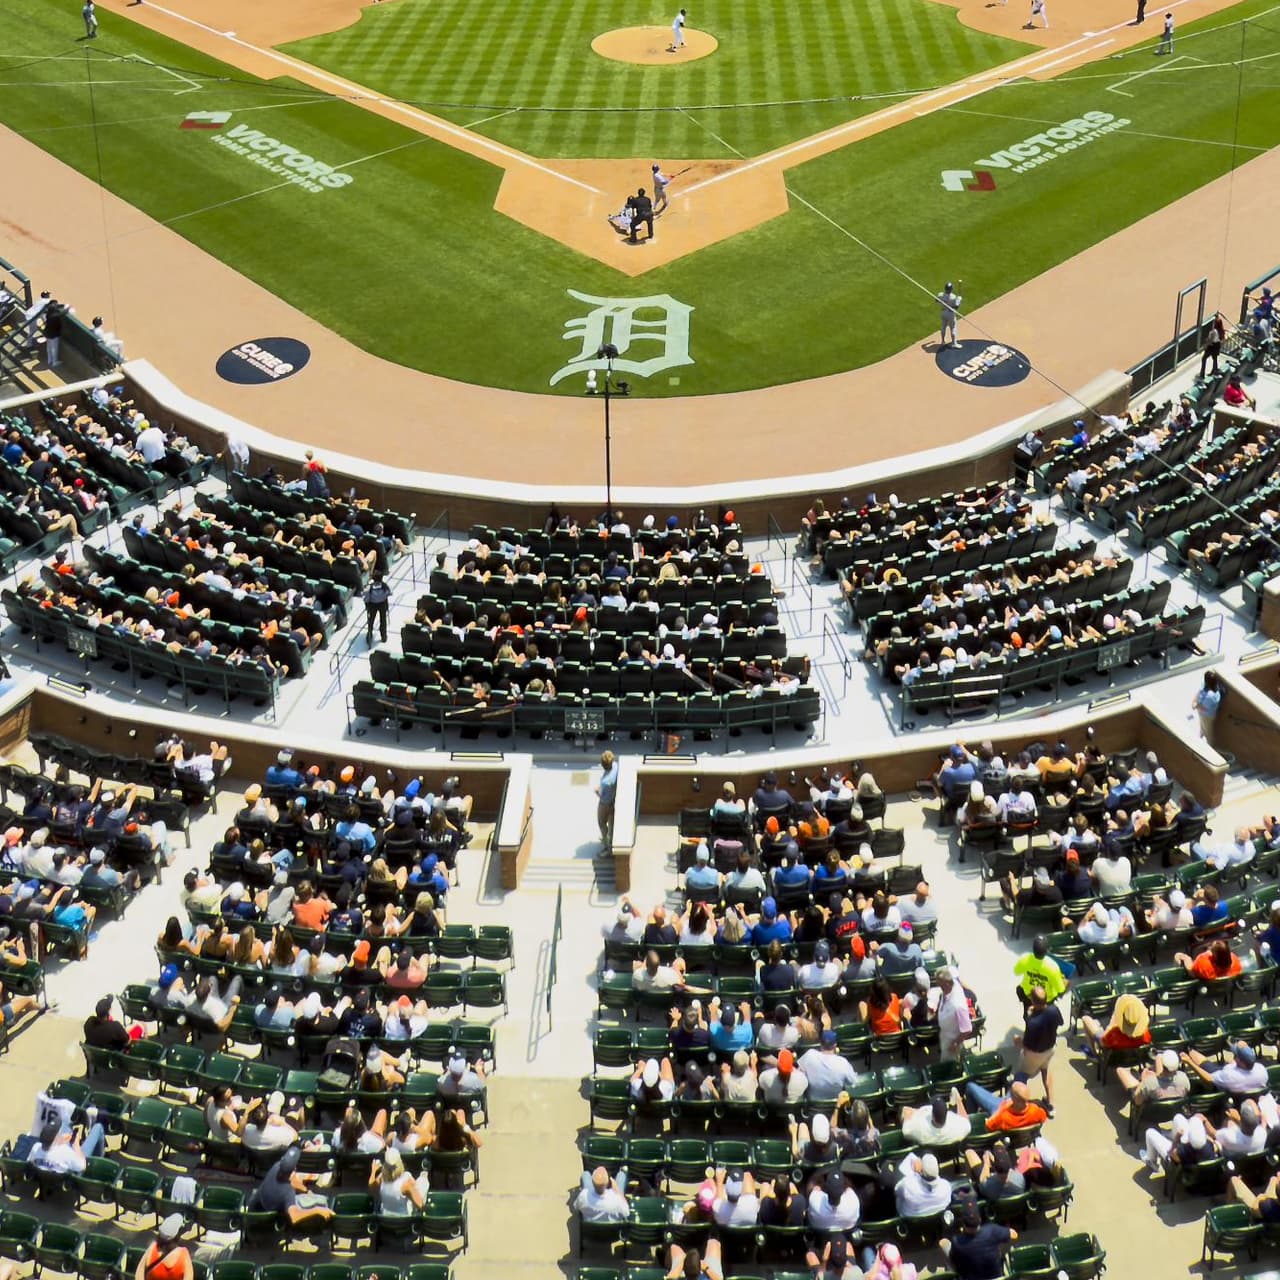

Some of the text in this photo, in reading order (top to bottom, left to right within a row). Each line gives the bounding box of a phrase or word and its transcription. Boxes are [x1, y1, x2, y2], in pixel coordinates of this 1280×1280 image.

[211, 134, 323, 193] HOME SOLUTIONS
[226, 124, 353, 188] VICTORS
[974, 111, 1114, 169] VICTORS
[1012, 118, 1131, 174] HOME SOLUTIONS
